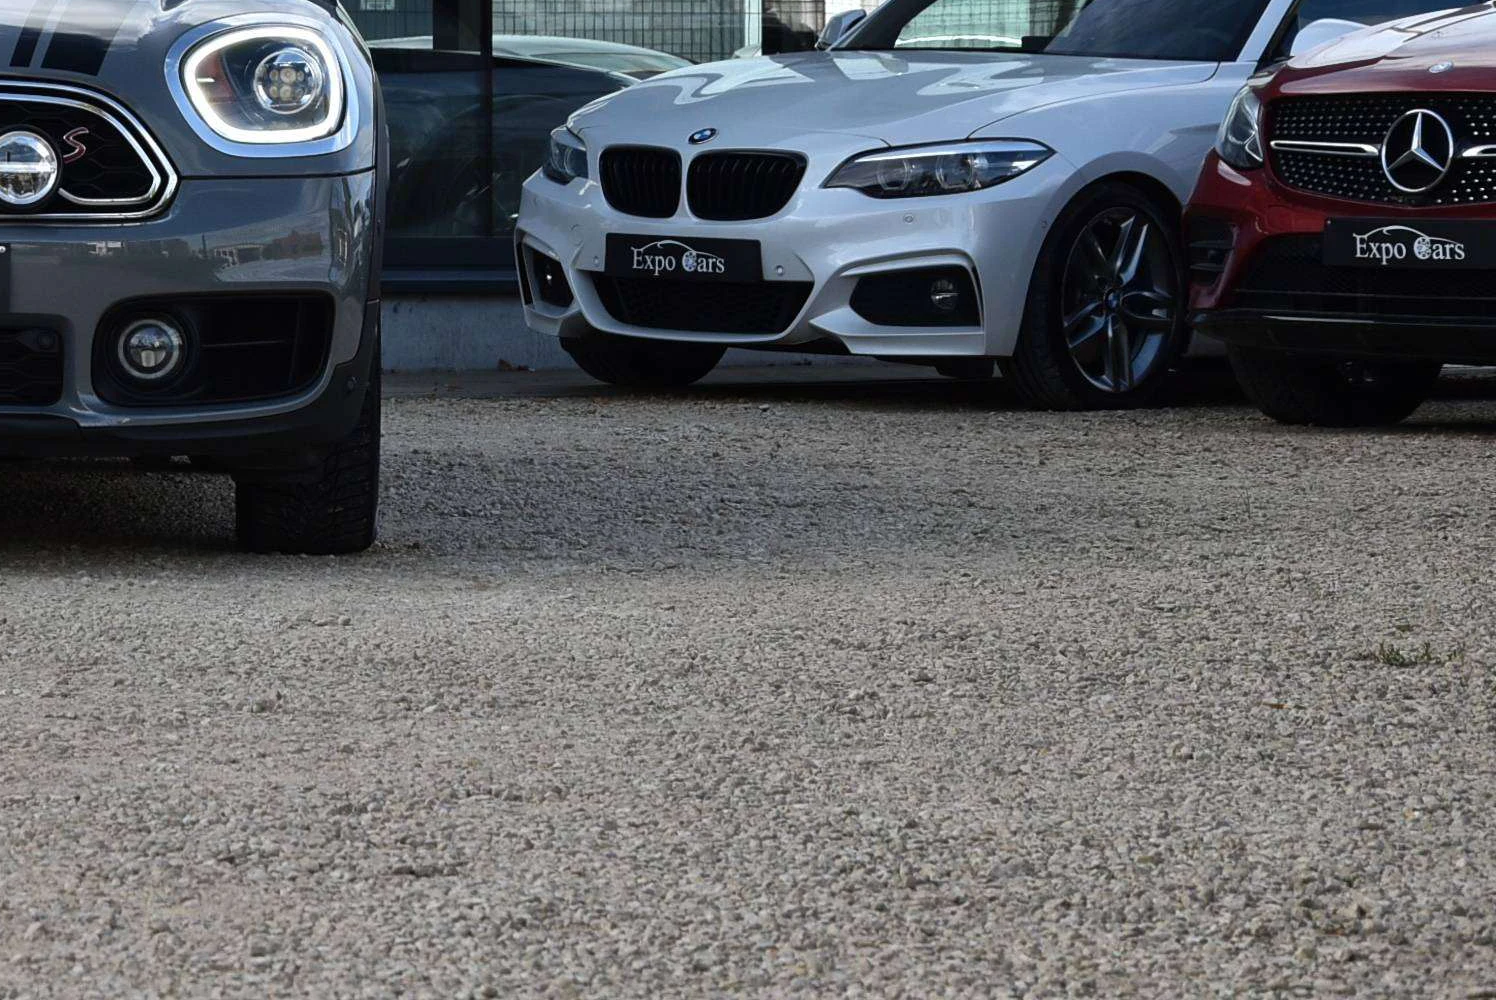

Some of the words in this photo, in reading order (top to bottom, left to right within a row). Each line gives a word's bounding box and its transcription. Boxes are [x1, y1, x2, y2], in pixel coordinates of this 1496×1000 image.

[631, 249, 676, 276] Expo
[681, 250, 725, 274] Cars
[1354, 235, 1407, 265] Expo
[1413, 236, 1465, 260] Cars
